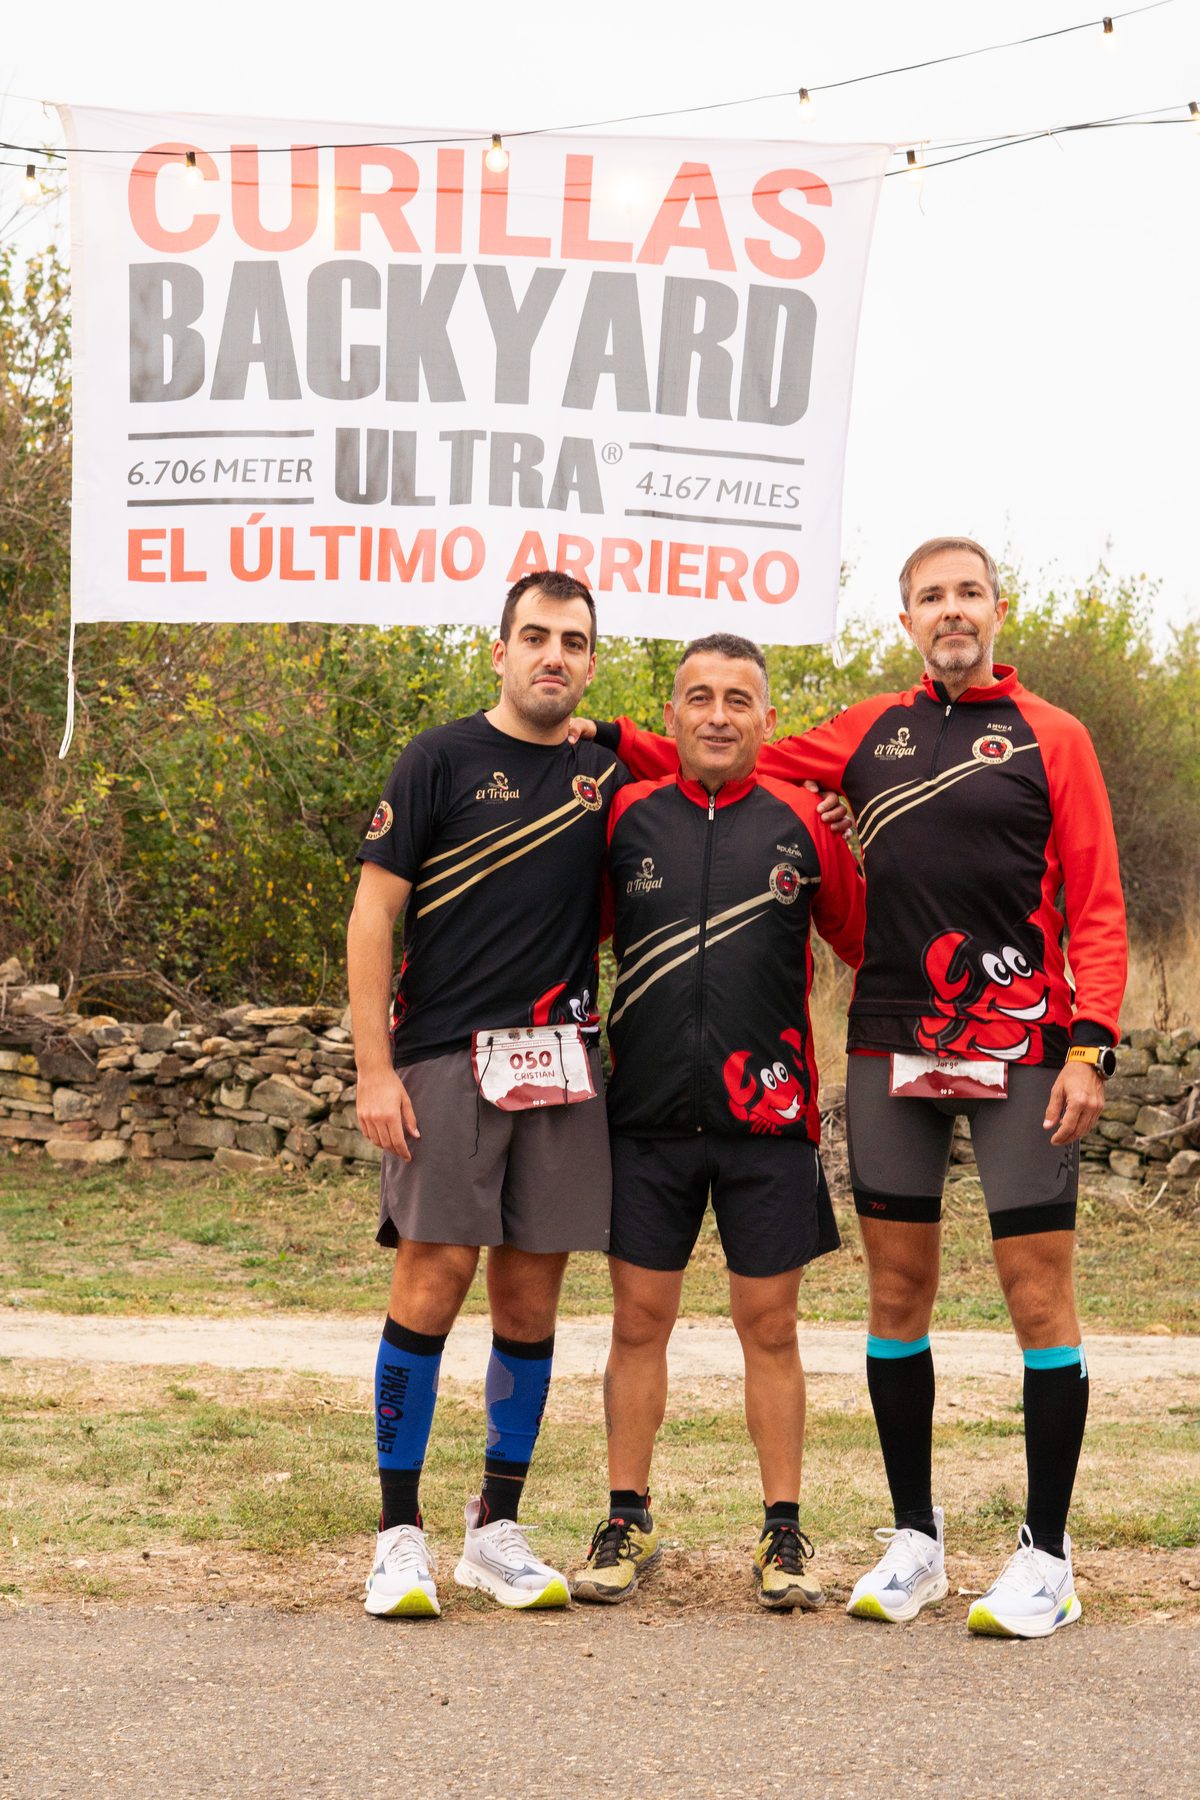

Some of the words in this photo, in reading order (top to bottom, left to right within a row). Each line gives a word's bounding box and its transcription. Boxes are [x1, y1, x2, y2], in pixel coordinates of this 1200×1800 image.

[127, 142, 833, 280] CURILLAS
[128, 259, 819, 427] BACKYARD
[127, 457, 207, 487] 6.706
[213, 458, 313, 484] METER
[636, 469, 712, 501] 4.167
[716, 479, 801, 510] MILES
[127, 528, 207, 582] EL
[230, 512, 487, 583] ÚLTIMO
[506, 530, 800, 604] ARRIERO
[874, 743, 885, 756] El
[885, 744, 917, 759] Trigal
[475, 789, 486, 800] El
[487, 788, 520, 802] Trigal
[633, 876, 664, 893] Trigal
[509, 1050, 553, 1070] 050
[935, 1059, 959, 1070] Jorge
[514, 1070, 556, 1081] CRISTIAN
[377, 1363, 412, 1455] ENFORMA
